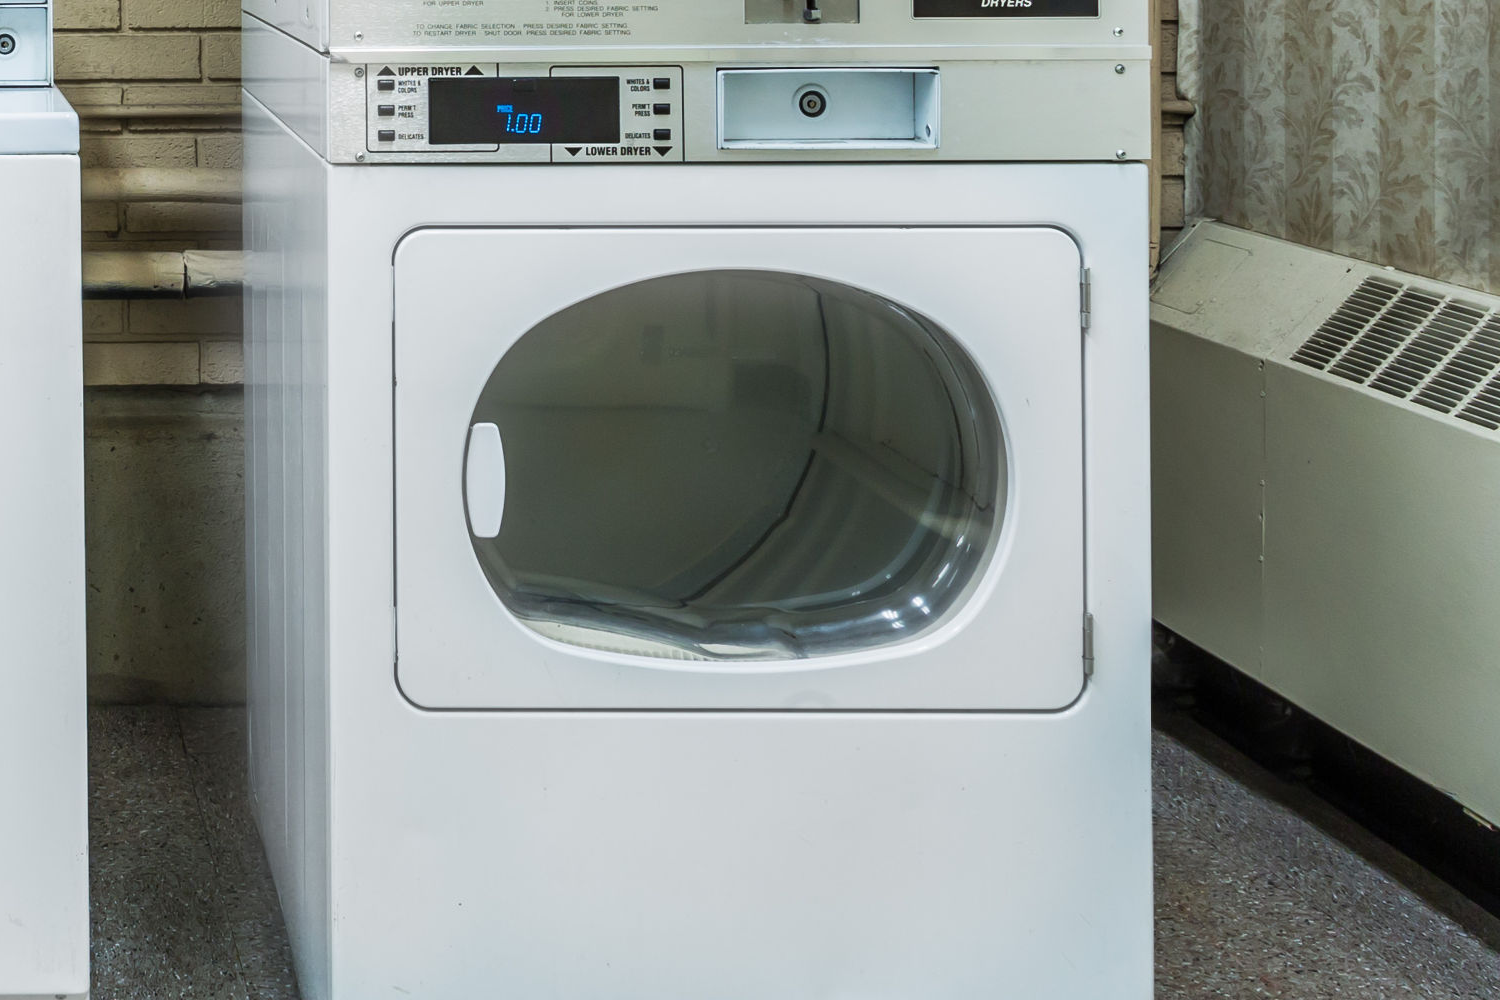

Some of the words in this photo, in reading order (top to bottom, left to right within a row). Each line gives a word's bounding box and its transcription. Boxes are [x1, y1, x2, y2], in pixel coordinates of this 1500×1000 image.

[398, 67, 429, 76] UPPER
[431, 67, 462, 76] DRYER
[506, 113, 542, 133] 1.00
[586, 147, 618, 156] LOWER
[620, 147, 651, 156] DRYER
